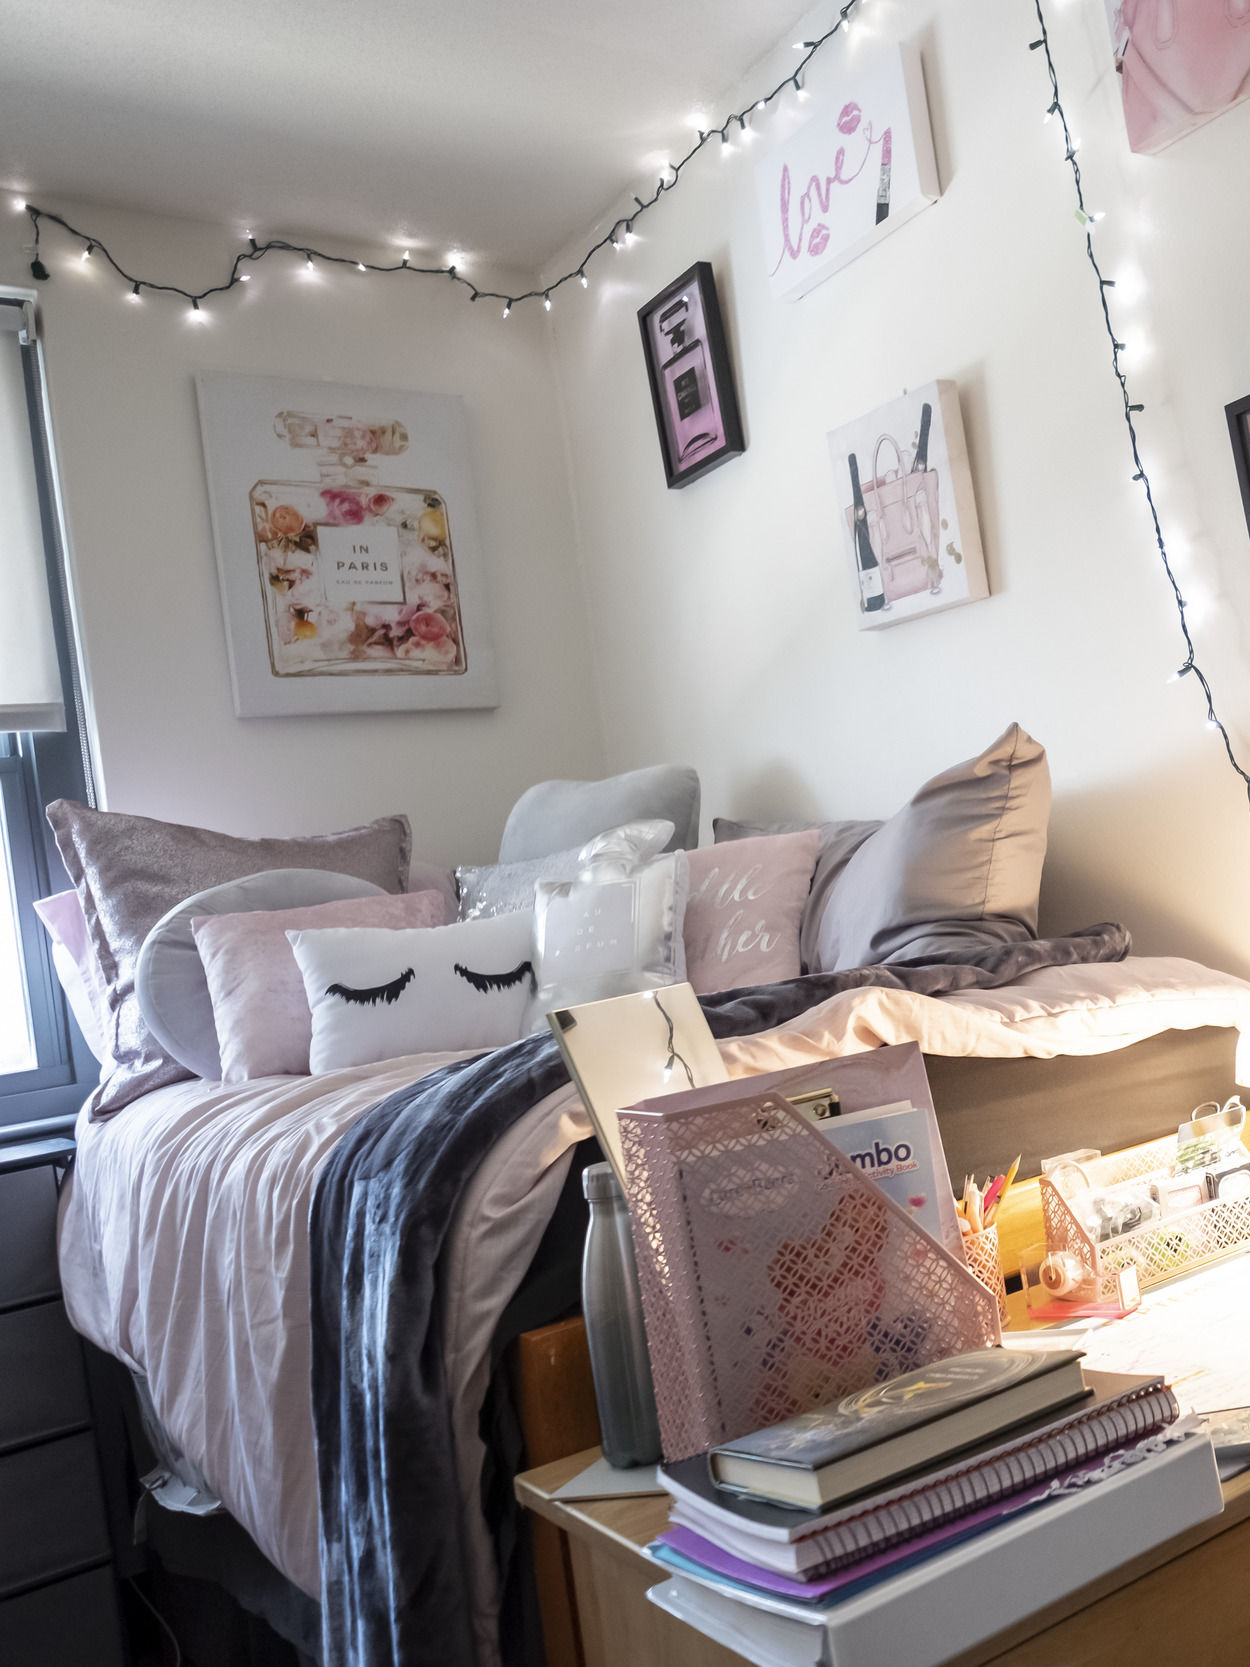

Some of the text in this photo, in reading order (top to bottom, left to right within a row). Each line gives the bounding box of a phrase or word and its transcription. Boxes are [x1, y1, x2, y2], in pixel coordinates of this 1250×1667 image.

[769, 121, 872, 277] love
[352, 544, 369, 554] IN
[336, 561, 389, 572] PARIS
